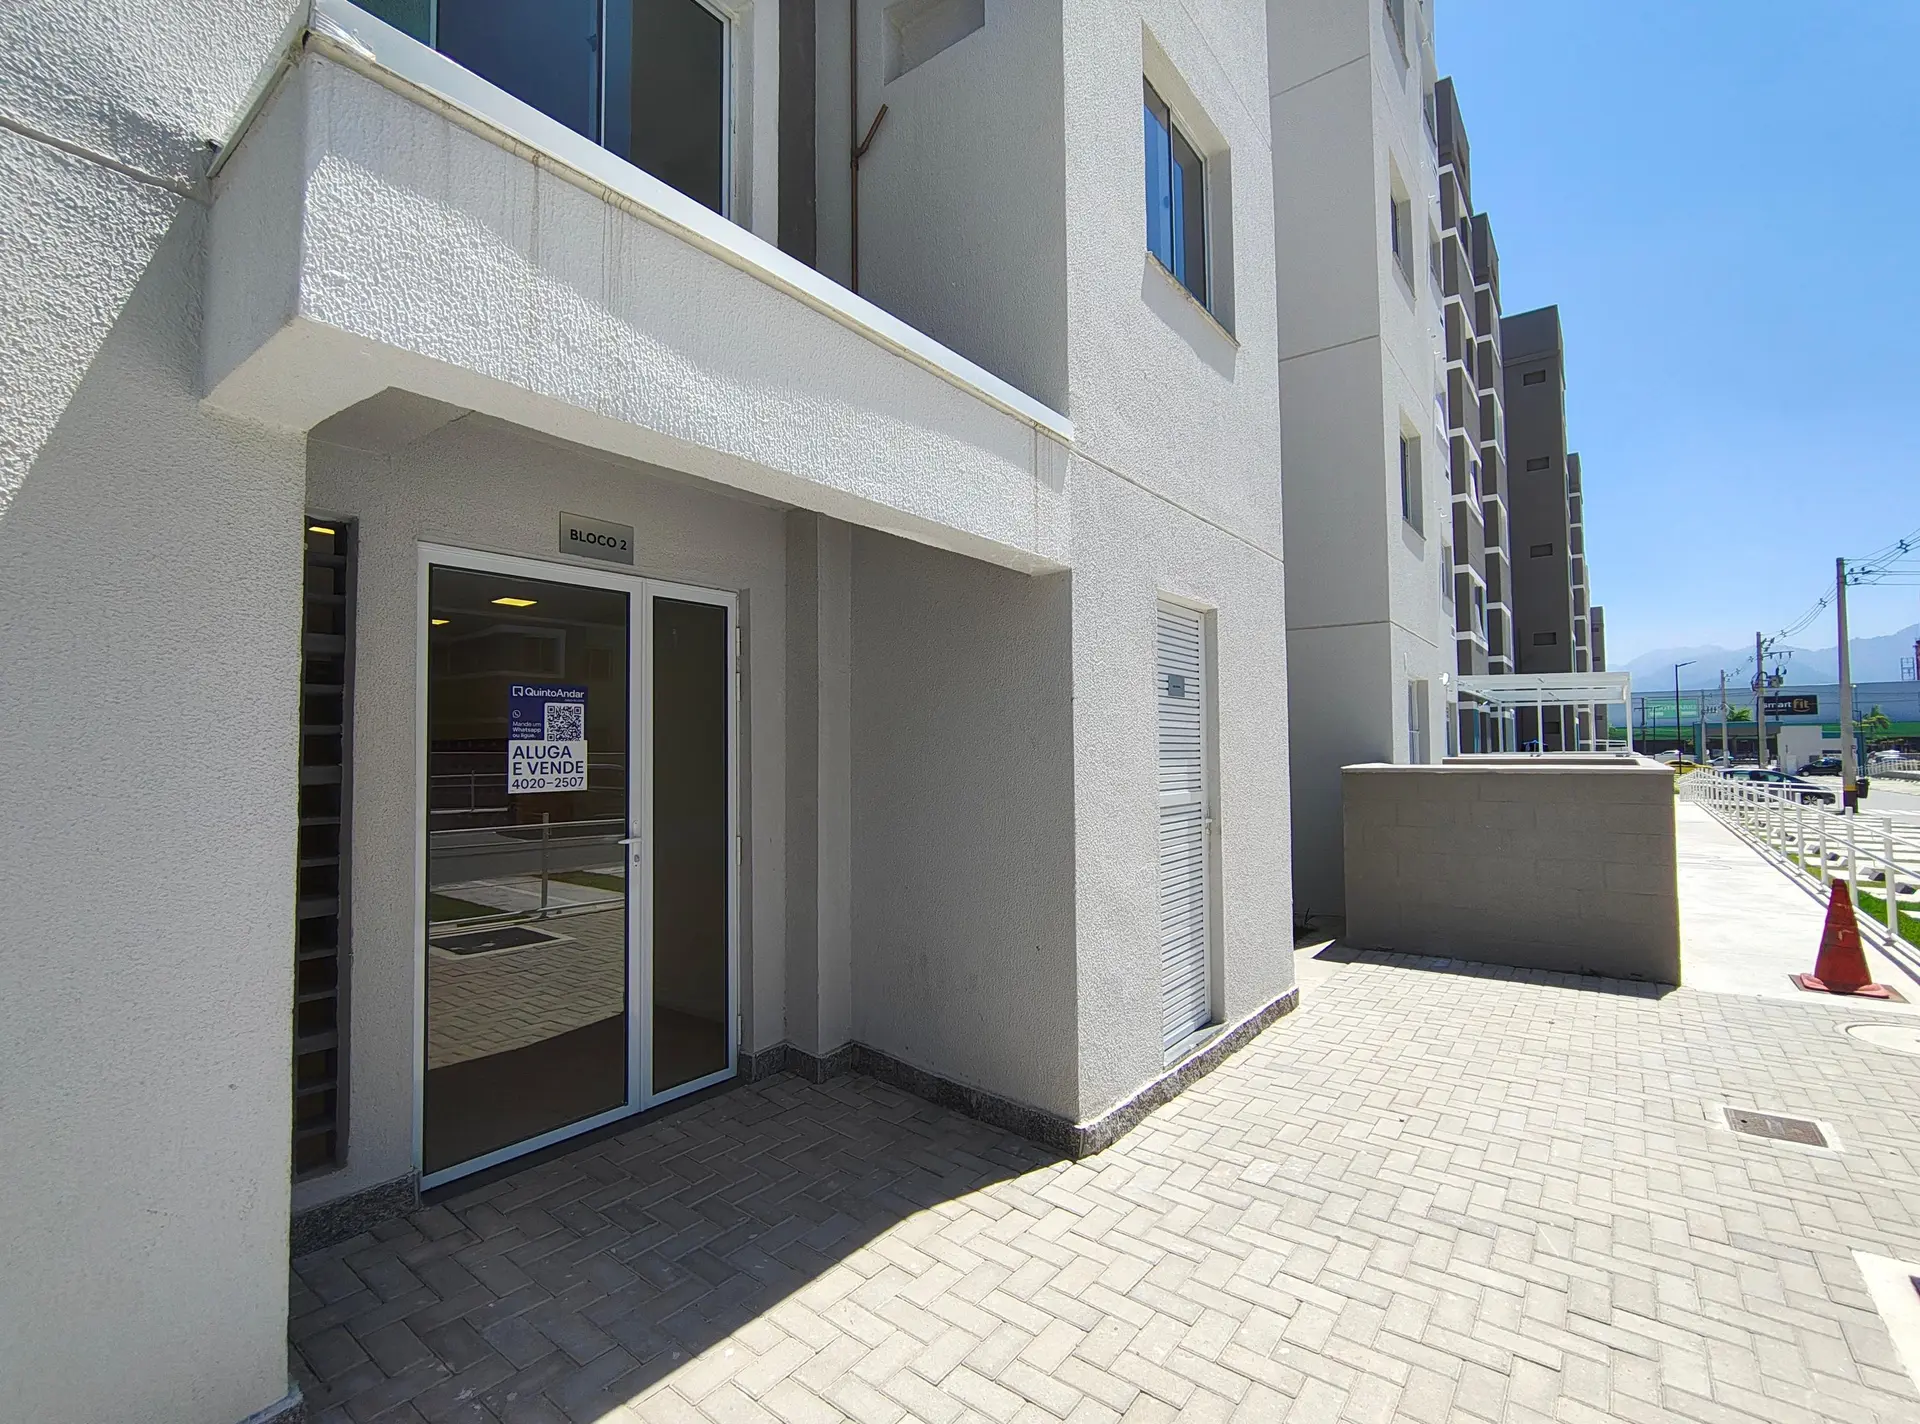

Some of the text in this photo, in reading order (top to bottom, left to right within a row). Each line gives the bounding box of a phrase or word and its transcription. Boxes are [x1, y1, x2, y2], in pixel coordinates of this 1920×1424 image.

[570, 528, 627, 551] BLOCO 2
[525, 687, 584, 698] QuintoAndar
[512, 745, 572, 760] ALUGA
[513, 760, 584, 775] E VENDE
[512, 777, 584, 789] 4020-2507
